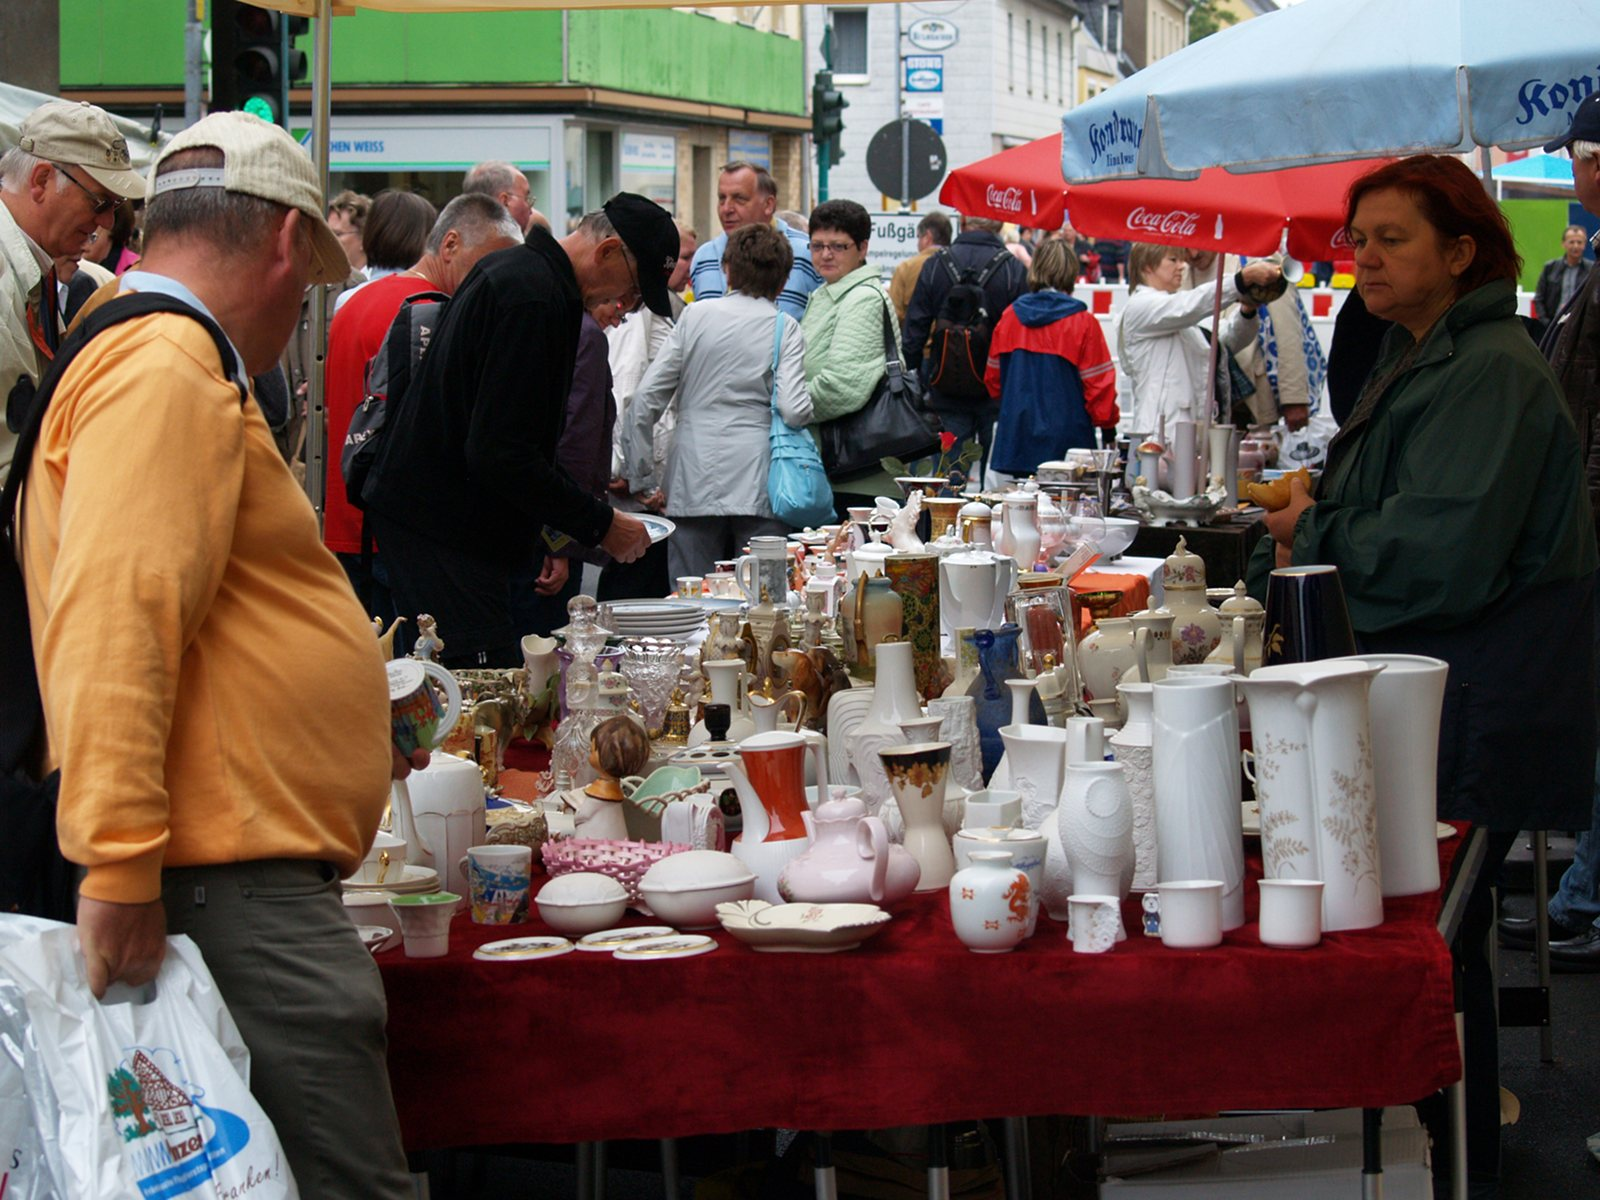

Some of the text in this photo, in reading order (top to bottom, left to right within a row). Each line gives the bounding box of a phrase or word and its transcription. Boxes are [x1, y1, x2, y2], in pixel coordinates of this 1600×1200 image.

[1516, 66, 1600, 125] Kon
[330, 141, 384, 153] HEN WEISS
[1089, 110, 1142, 165] Kondrau
[986, 183, 1023, 212] Coca-Cola
[871, 222, 919, 243] Fußgä
[1126, 206, 1200, 236] Coca-Cola
